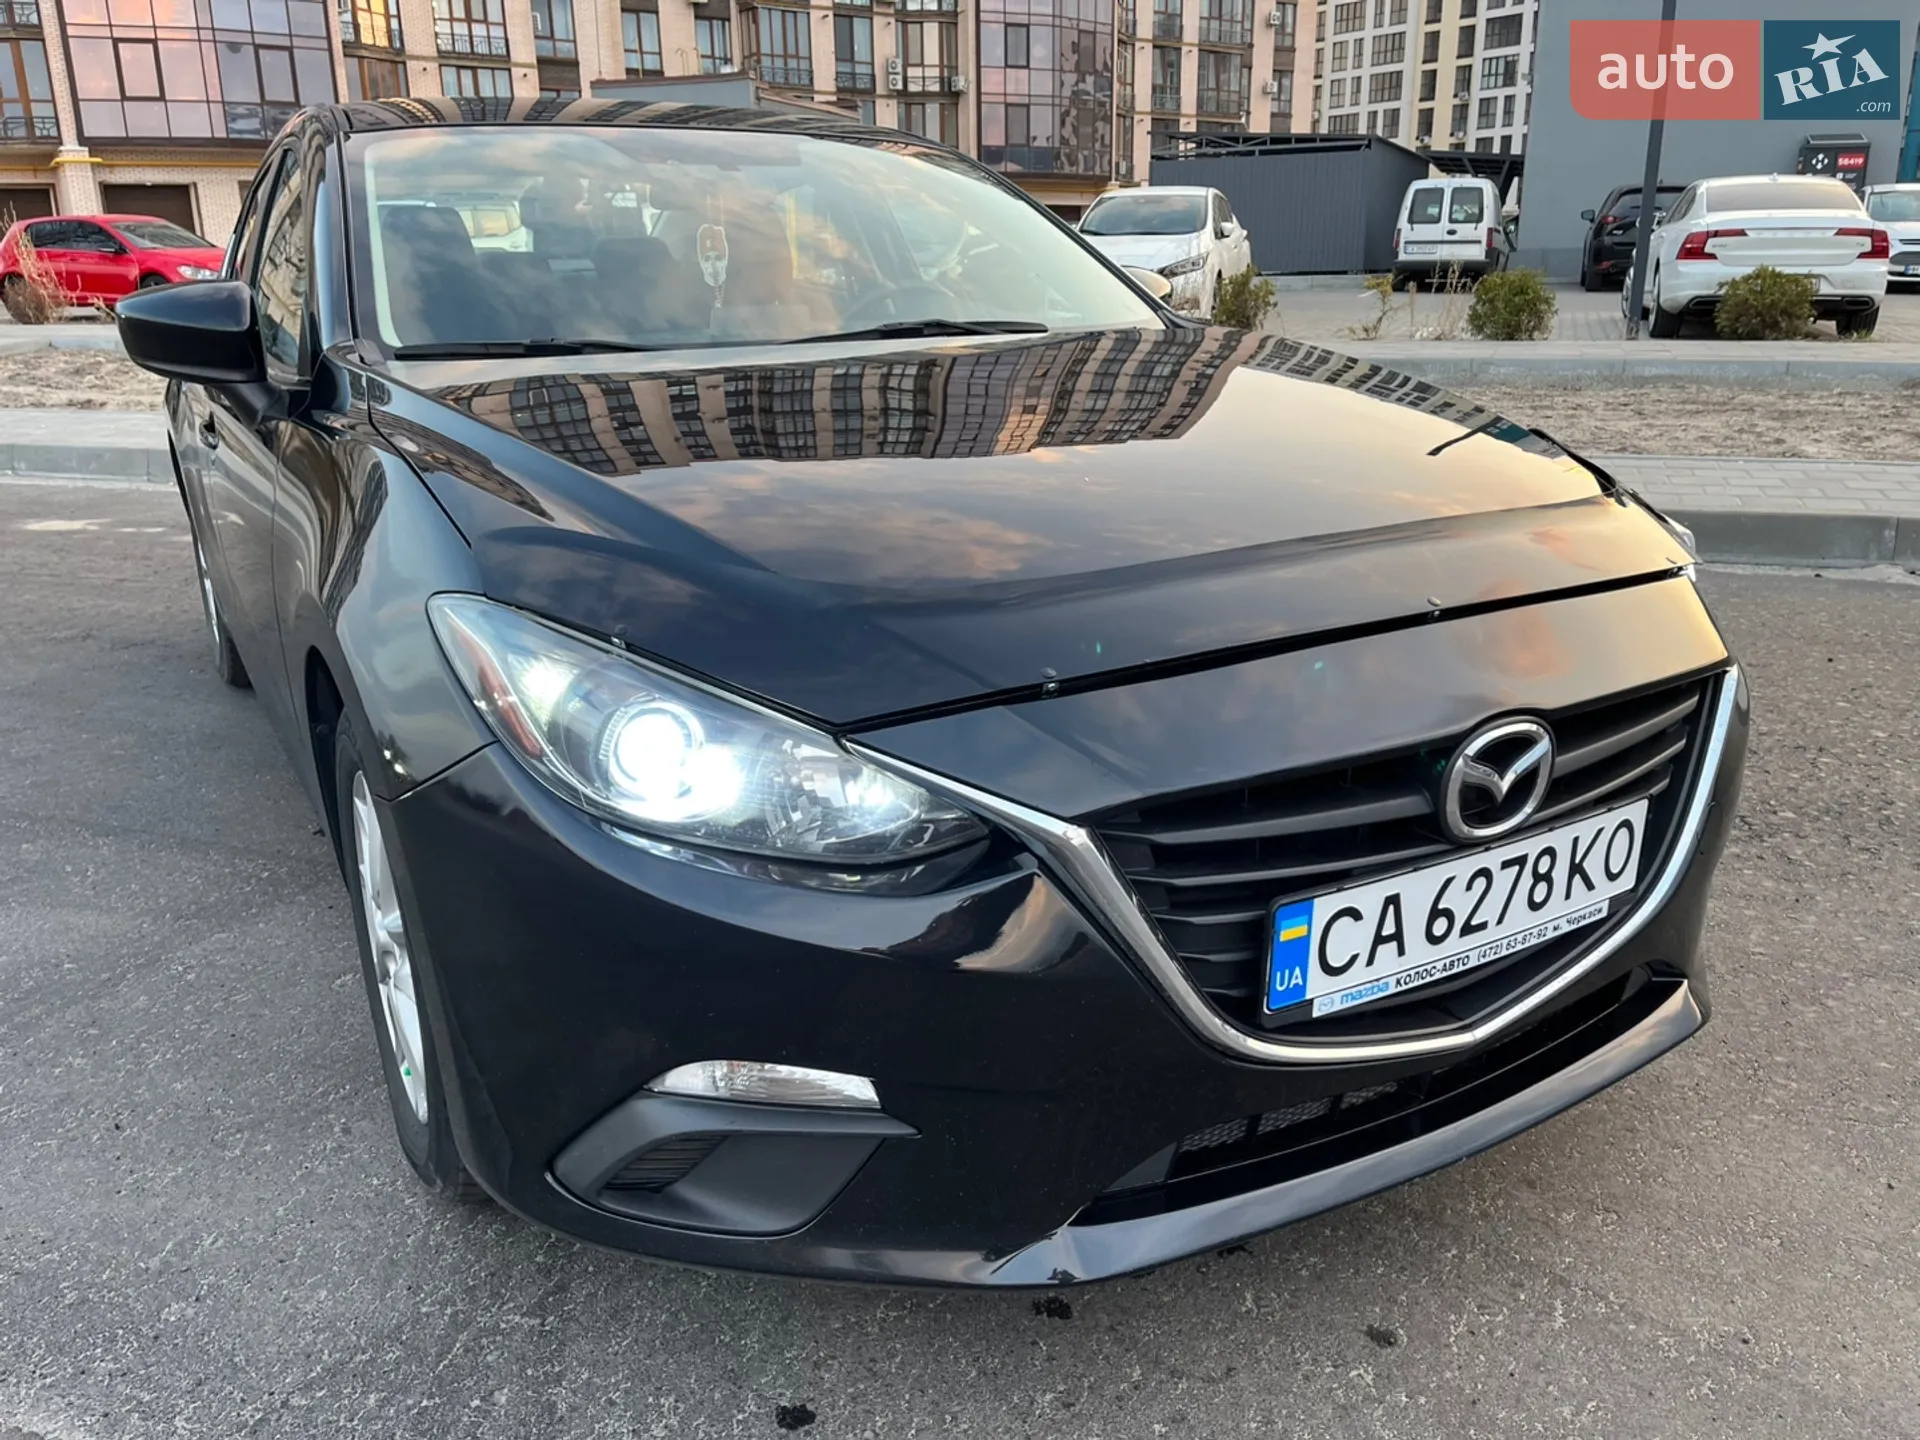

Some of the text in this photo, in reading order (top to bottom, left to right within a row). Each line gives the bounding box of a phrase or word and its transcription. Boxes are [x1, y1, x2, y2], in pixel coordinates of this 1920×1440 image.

[1318, 892, 1406, 977] CA
[1395, 954, 1470, 988] КОЛОС-АВТО
[1477, 942, 1503, 963] (472)
[1505, 926, 1549, 951] 63-87-92
[1566, 906, 1604, 927] Черкаси
[1275, 968, 1303, 991] UA
